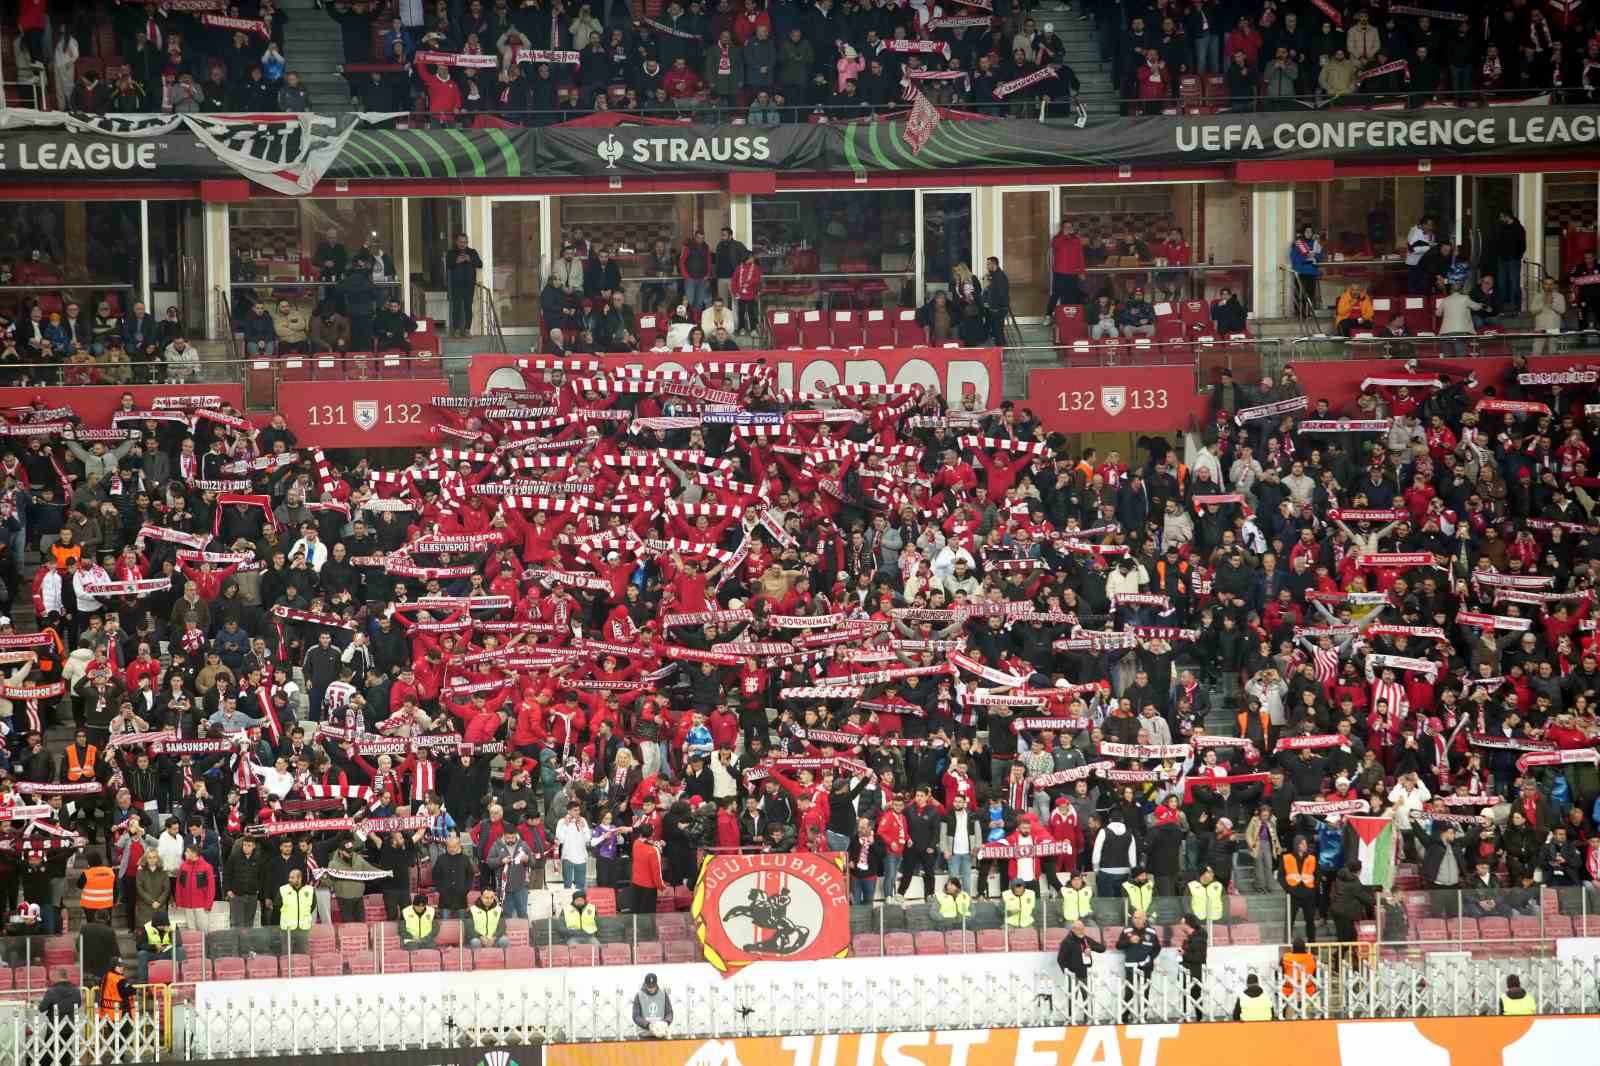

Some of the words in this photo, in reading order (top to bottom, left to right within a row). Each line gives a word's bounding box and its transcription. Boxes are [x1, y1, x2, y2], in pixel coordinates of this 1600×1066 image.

[1176, 124, 1264, 151] UEFA
[1273, 118, 1495, 149] CONFERENCE
[19, 143, 156, 170] LEAGUE
[632, 136, 770, 162] STRAUSS
[1057, 391, 1095, 411] 132
[1130, 389, 1168, 409] 133
[308, 405, 347, 425] 131
[384, 403, 422, 424] 132
[703, 415, 734, 423] ORDU
[1026, 719, 1077, 729] SAMSUNSPOR
[166, 742, 220, 752] SAMSUNSPOR
[359, 744, 404, 754] SAMSUNSPOR
[781, 1028, 990, 1066] JUST
[1014, 1024, 1180, 1066] EAT
